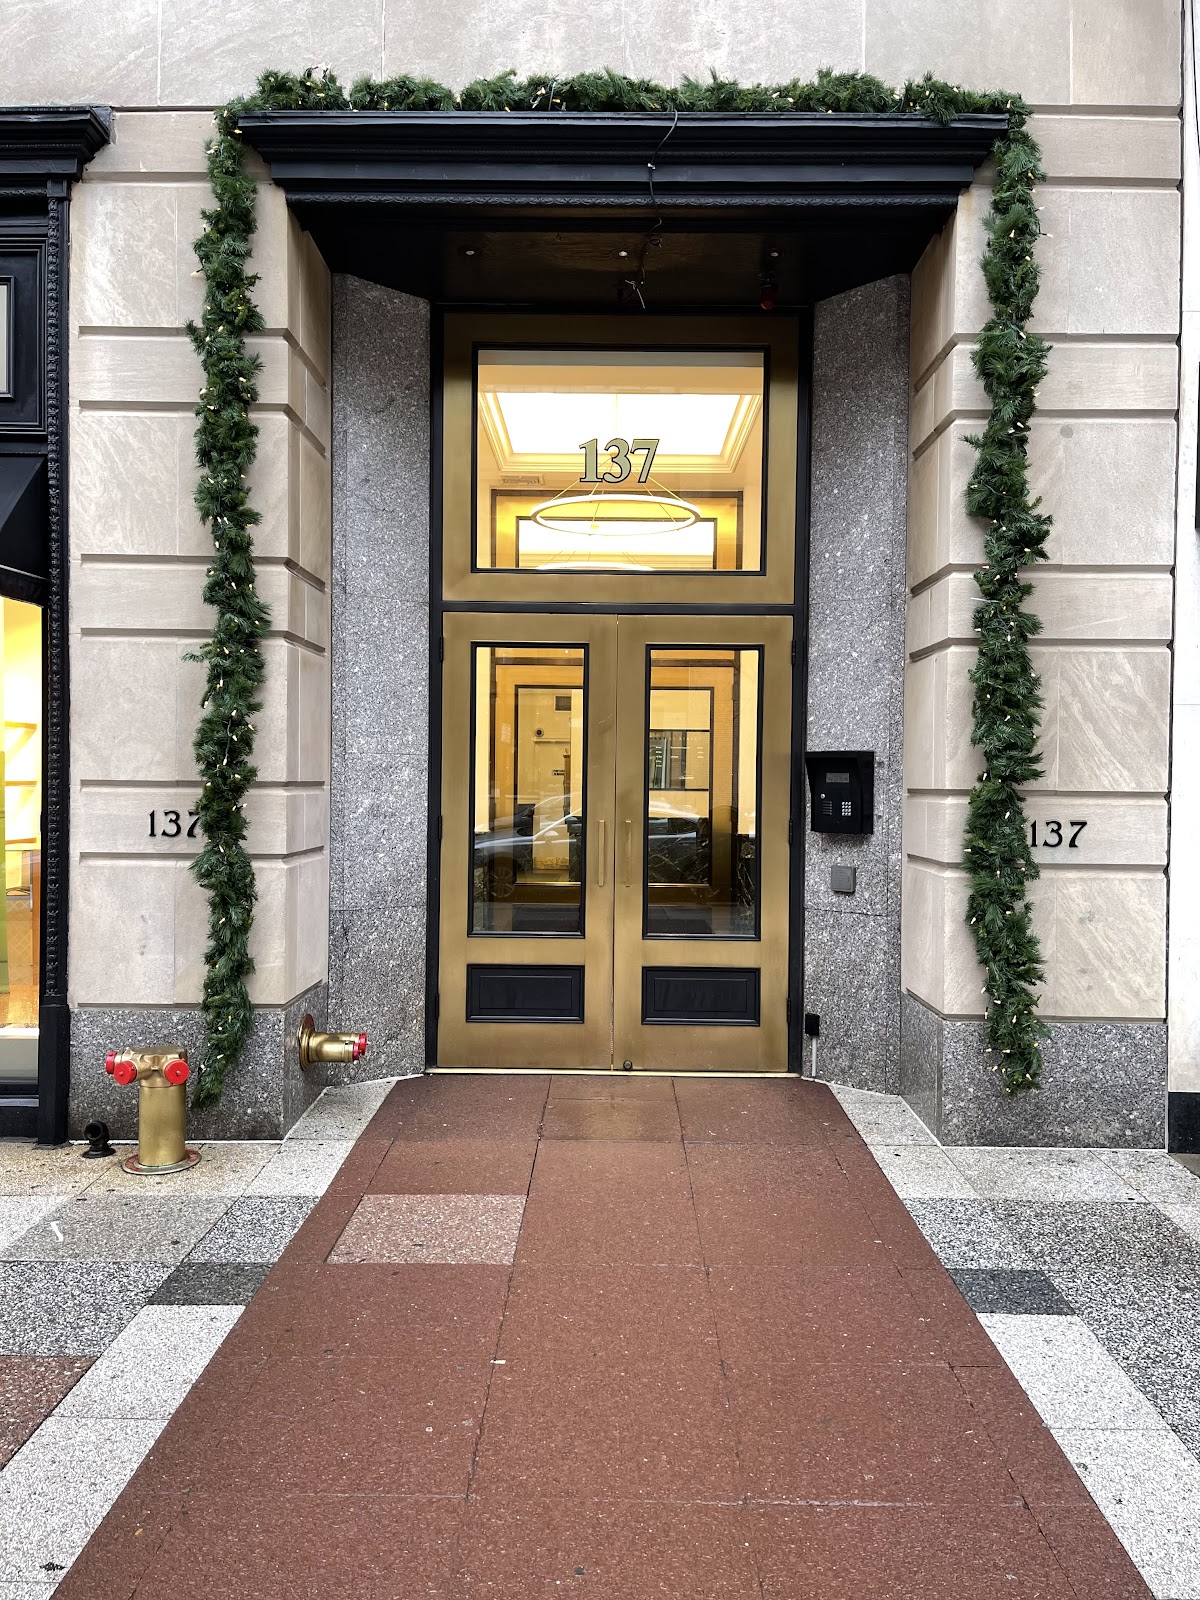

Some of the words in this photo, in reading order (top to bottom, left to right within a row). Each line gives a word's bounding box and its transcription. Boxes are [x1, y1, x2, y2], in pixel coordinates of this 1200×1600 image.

[578, 437, 660, 484] 137
[149, 809, 201, 838] 137
[1030, 819, 1088, 848] 137
